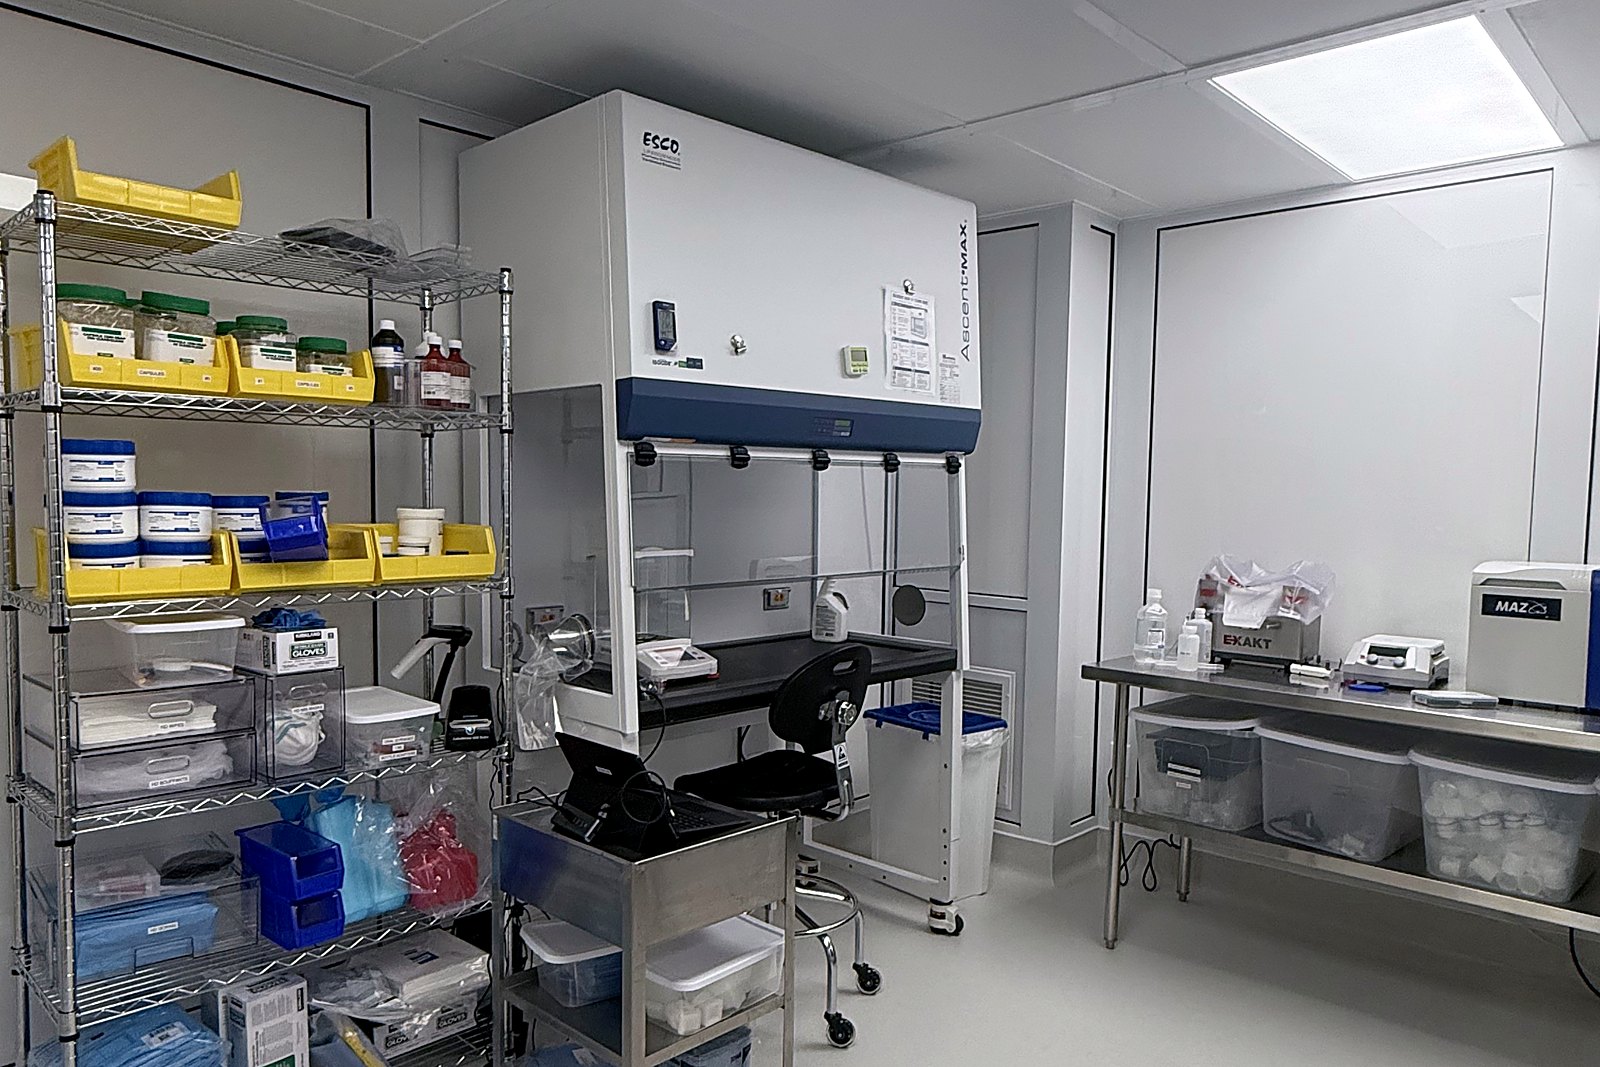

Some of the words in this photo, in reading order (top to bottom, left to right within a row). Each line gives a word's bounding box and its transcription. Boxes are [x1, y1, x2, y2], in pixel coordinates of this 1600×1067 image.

[643, 131, 679, 154] ESCO
[1223, 634, 1272, 650] EXAKT
[292, 648, 324, 658] GLOVES
